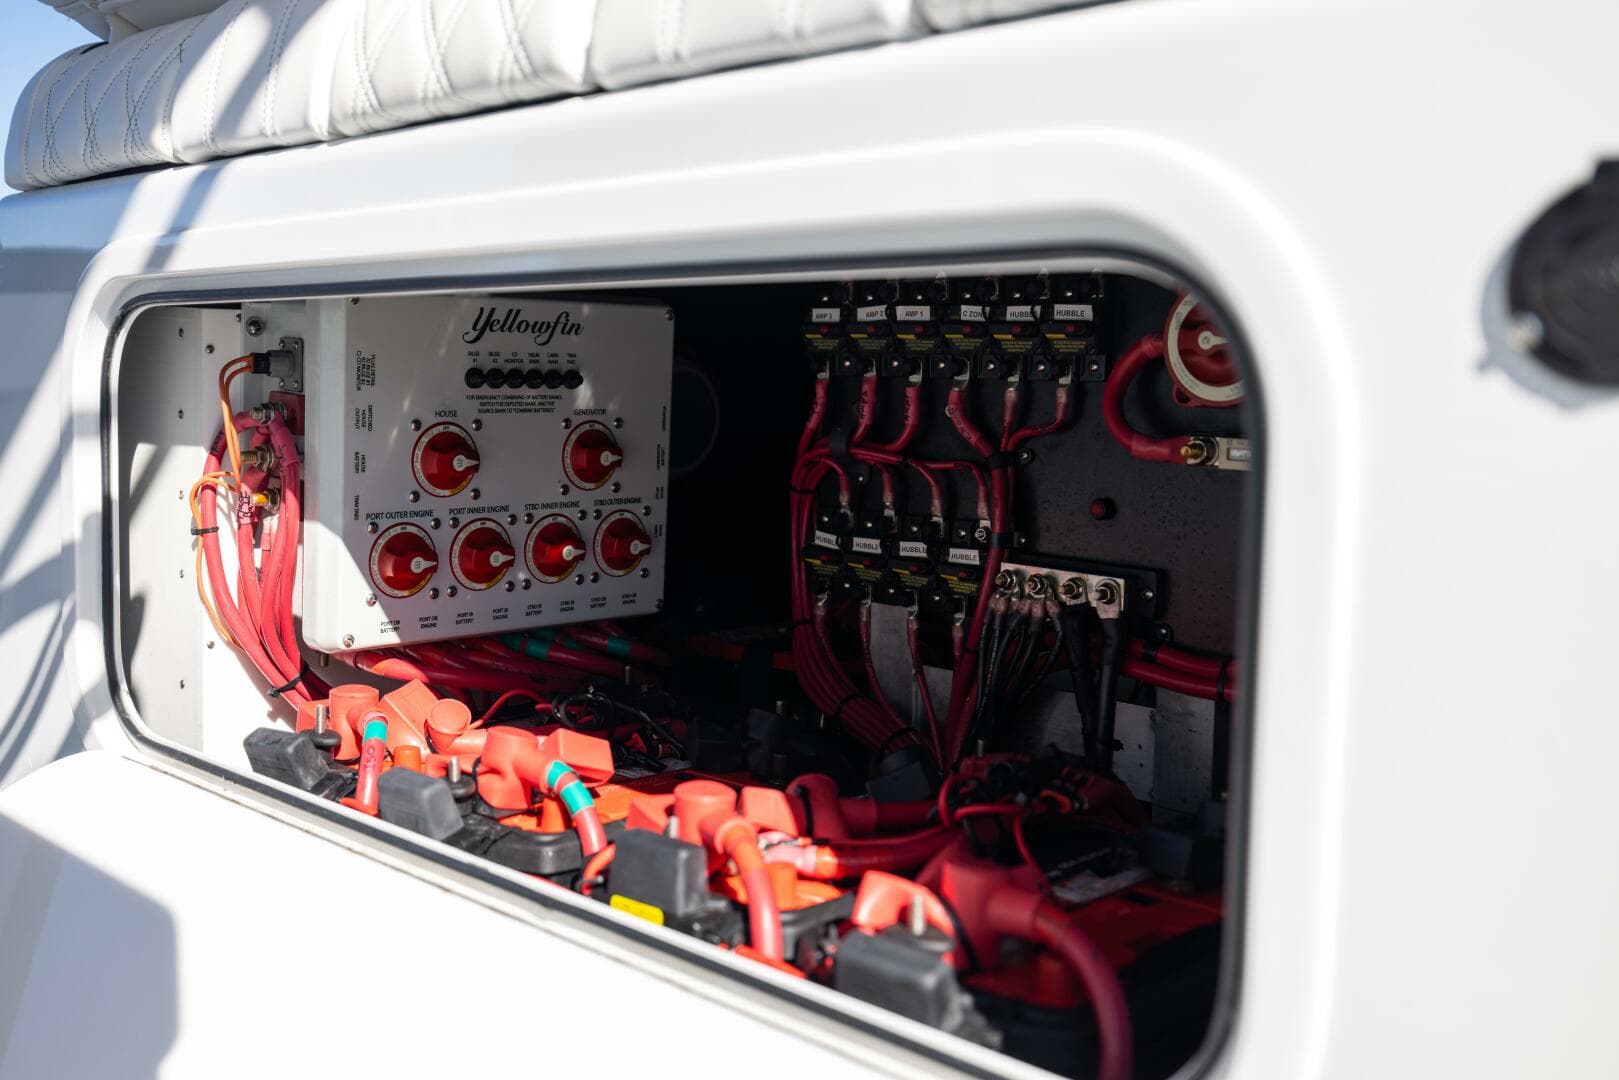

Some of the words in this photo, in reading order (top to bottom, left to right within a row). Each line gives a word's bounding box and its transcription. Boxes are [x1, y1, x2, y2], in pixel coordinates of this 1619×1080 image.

[1056, 309, 1085, 317] HUBBLE
[462, 307, 584, 346] Yellowfin
[434, 410, 458, 418] HOUSE
[573, 408, 607, 416] GENERATOR
[540, 502, 559, 510] INNER
[607, 498, 624, 506] OUTER
[449, 507, 466, 516] PORT
[466, 506, 487, 515] INNER
[487, 504, 510, 513] ENGINE
[365, 512, 385, 520] PORT
[386, 511, 409, 519] OUTER
[409, 509, 434, 518] ENGINE
[815, 535, 838, 546] HUBBL
[855, 541, 879, 550] HUBBLE
[902, 546, 928, 554] HUBBLE
[951, 553, 977, 561] HUBBLE
